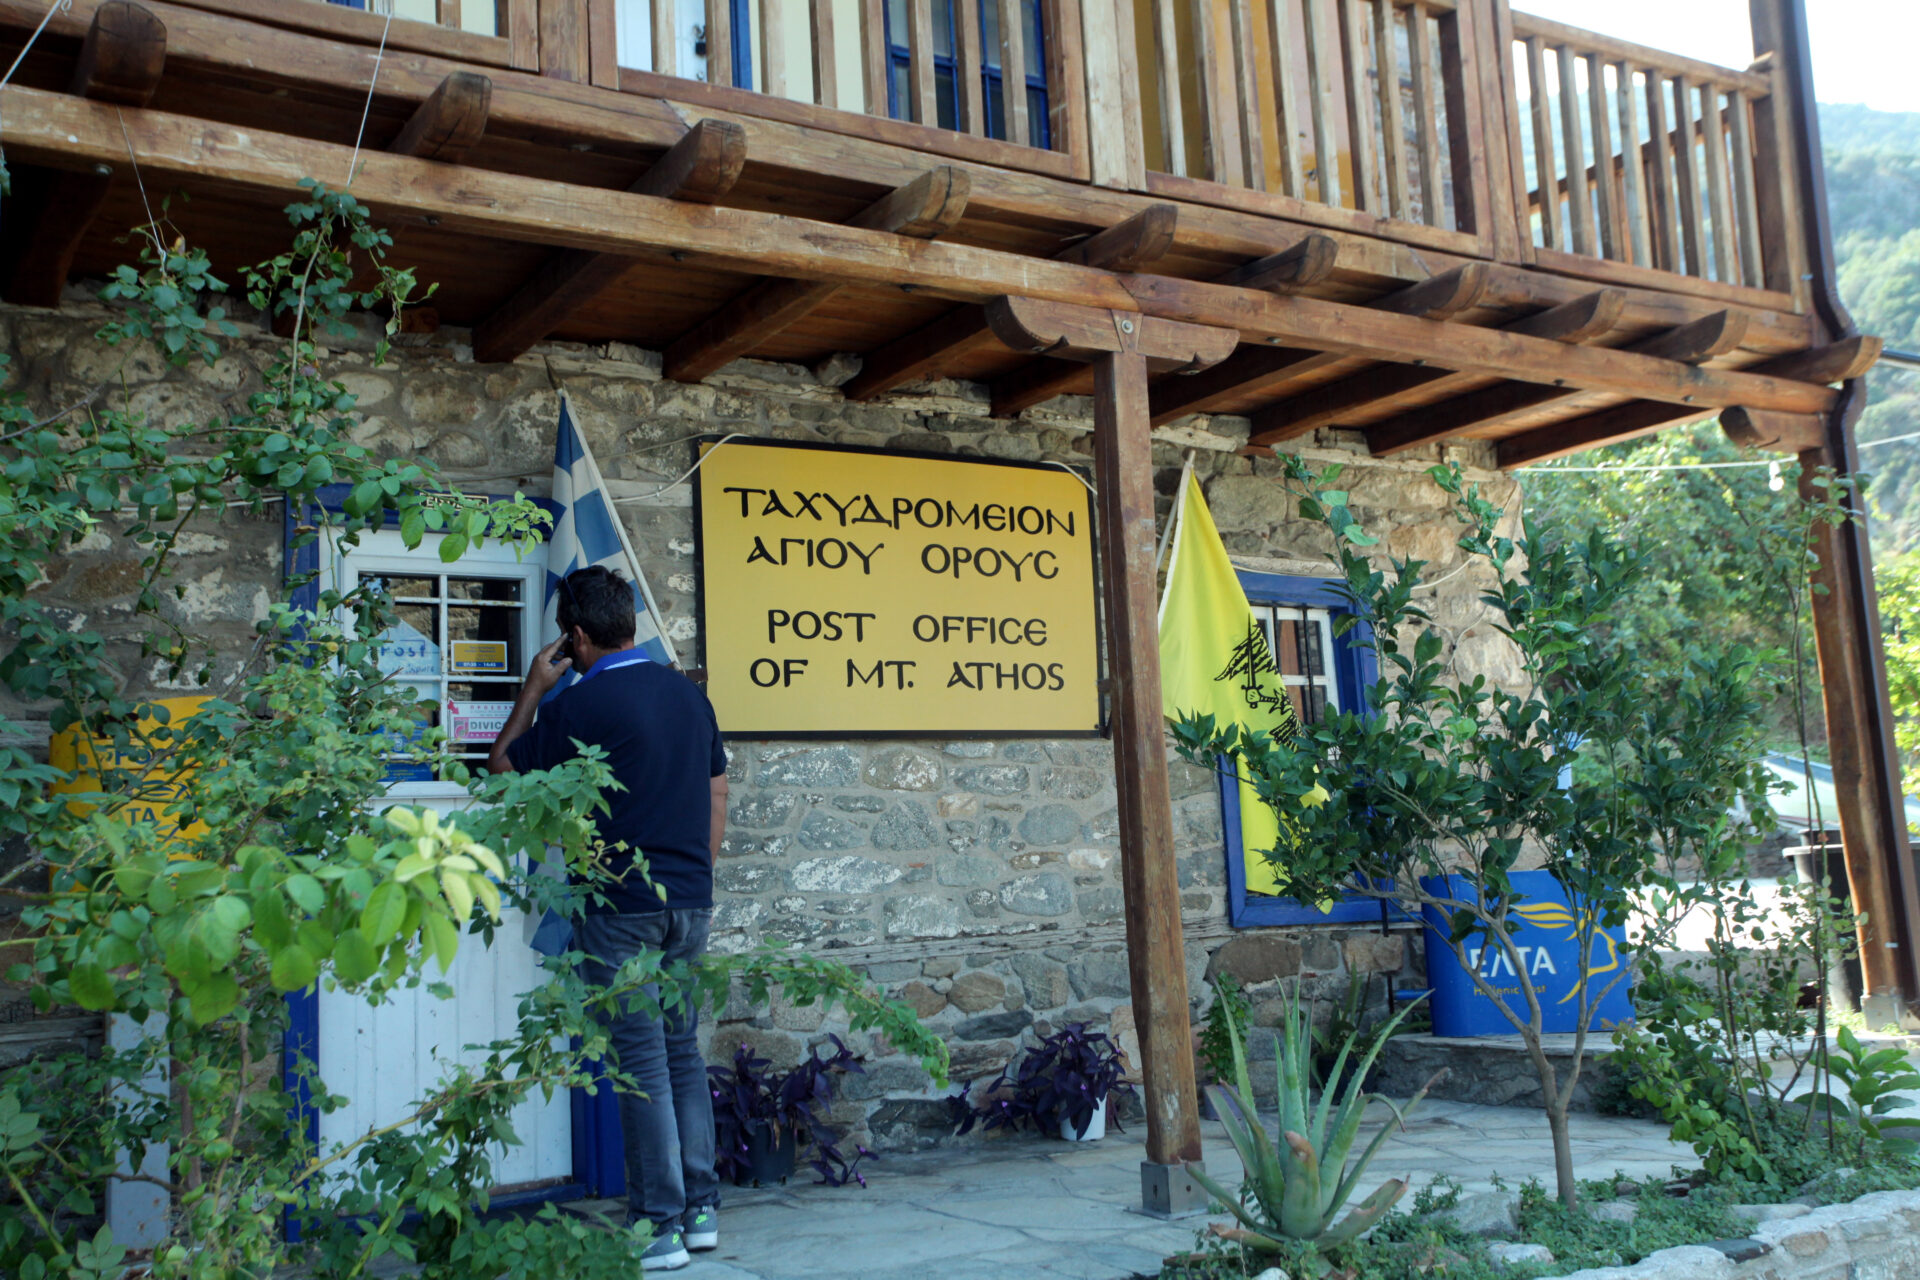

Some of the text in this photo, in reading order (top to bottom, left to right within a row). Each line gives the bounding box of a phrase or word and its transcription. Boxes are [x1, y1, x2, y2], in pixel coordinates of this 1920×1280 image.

[746, 536, 884, 574] ΑΓΙΟΥ
[768, 609, 1048, 646] POST OFFICE
[749, 658, 1064, 691] OF MT. ATHOS
[470, 721, 505, 730] DIVIC
